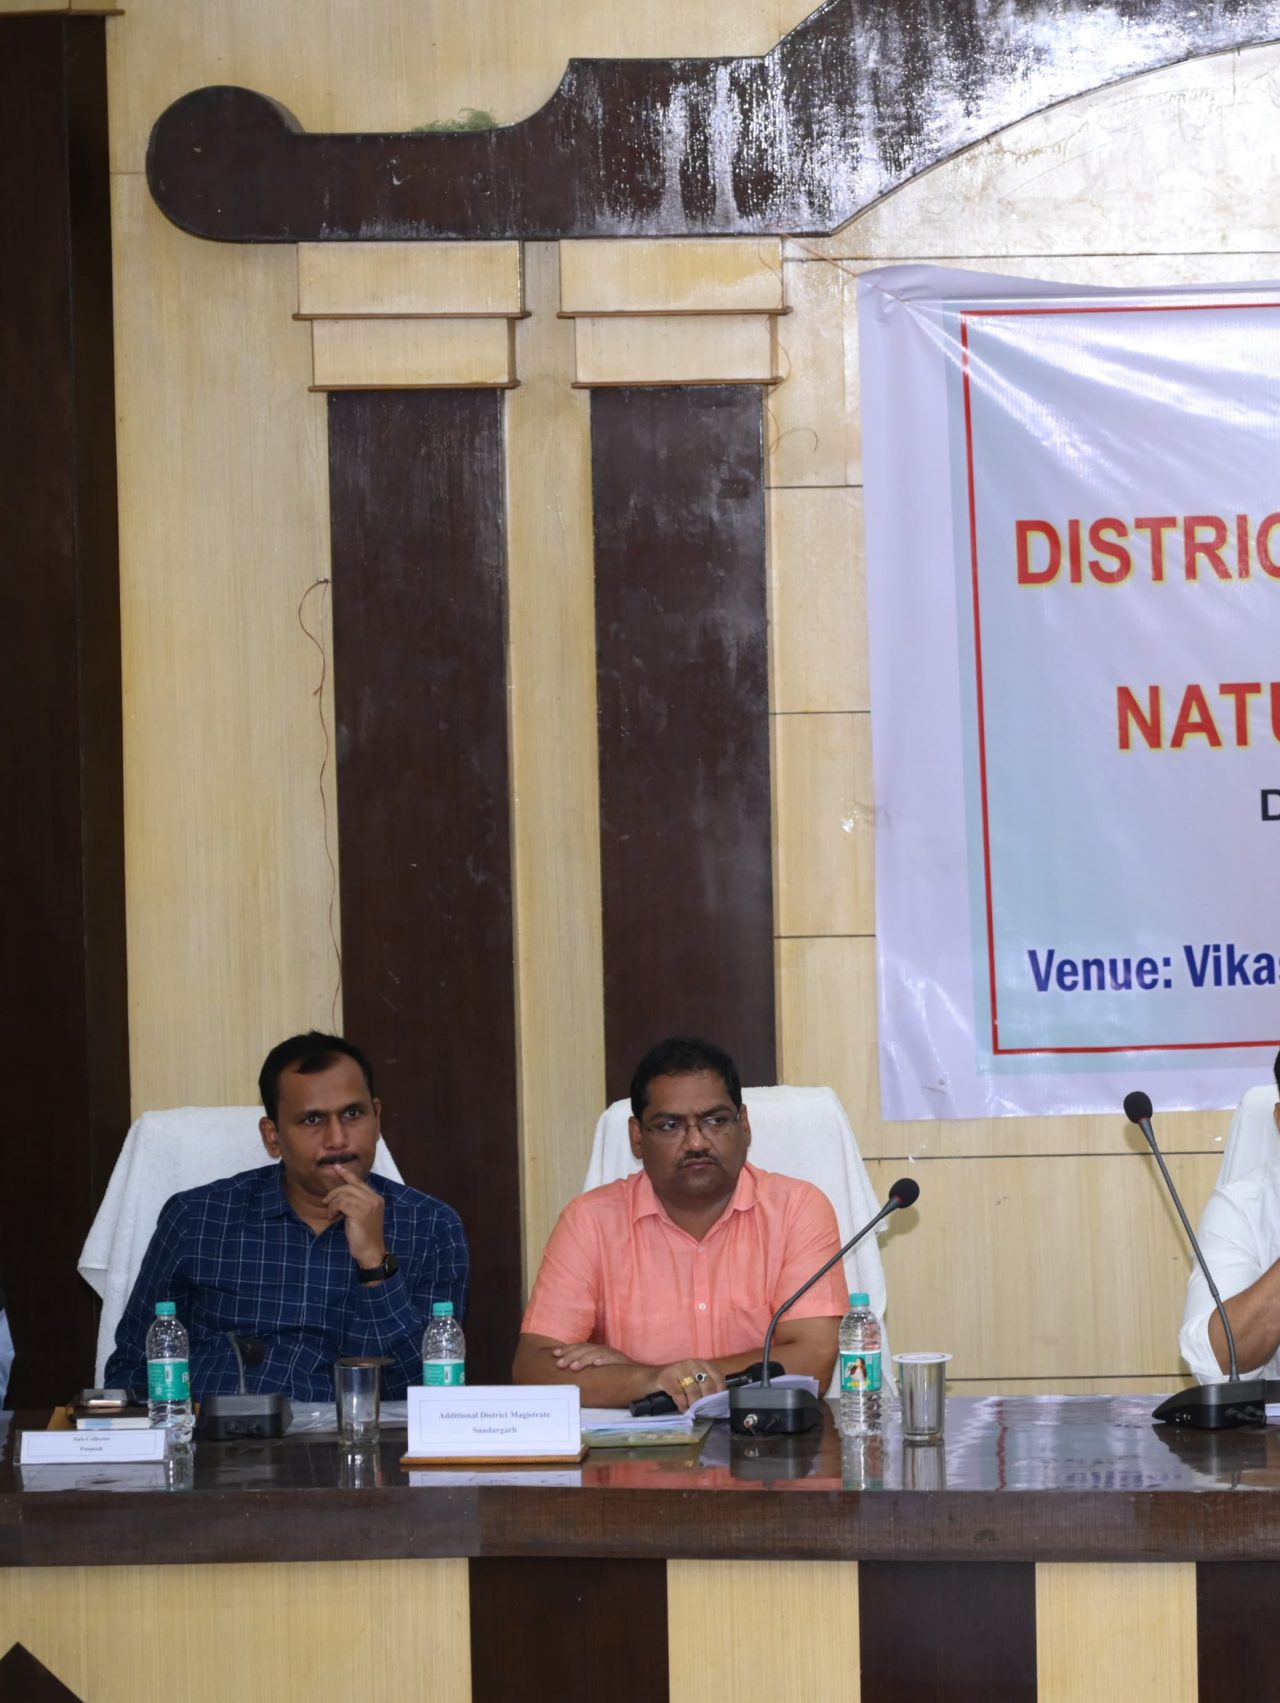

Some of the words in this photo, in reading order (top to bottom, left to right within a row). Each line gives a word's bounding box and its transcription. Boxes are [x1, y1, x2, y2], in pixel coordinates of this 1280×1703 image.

[1027, 948, 1173, 992] Venue:
[438, 1411, 478, 1420] Additional
[480, 1411, 508, 1419] District
[510, 1411, 551, 1420] Magistrate
[472, 1426, 517, 1435] Sundargarh
